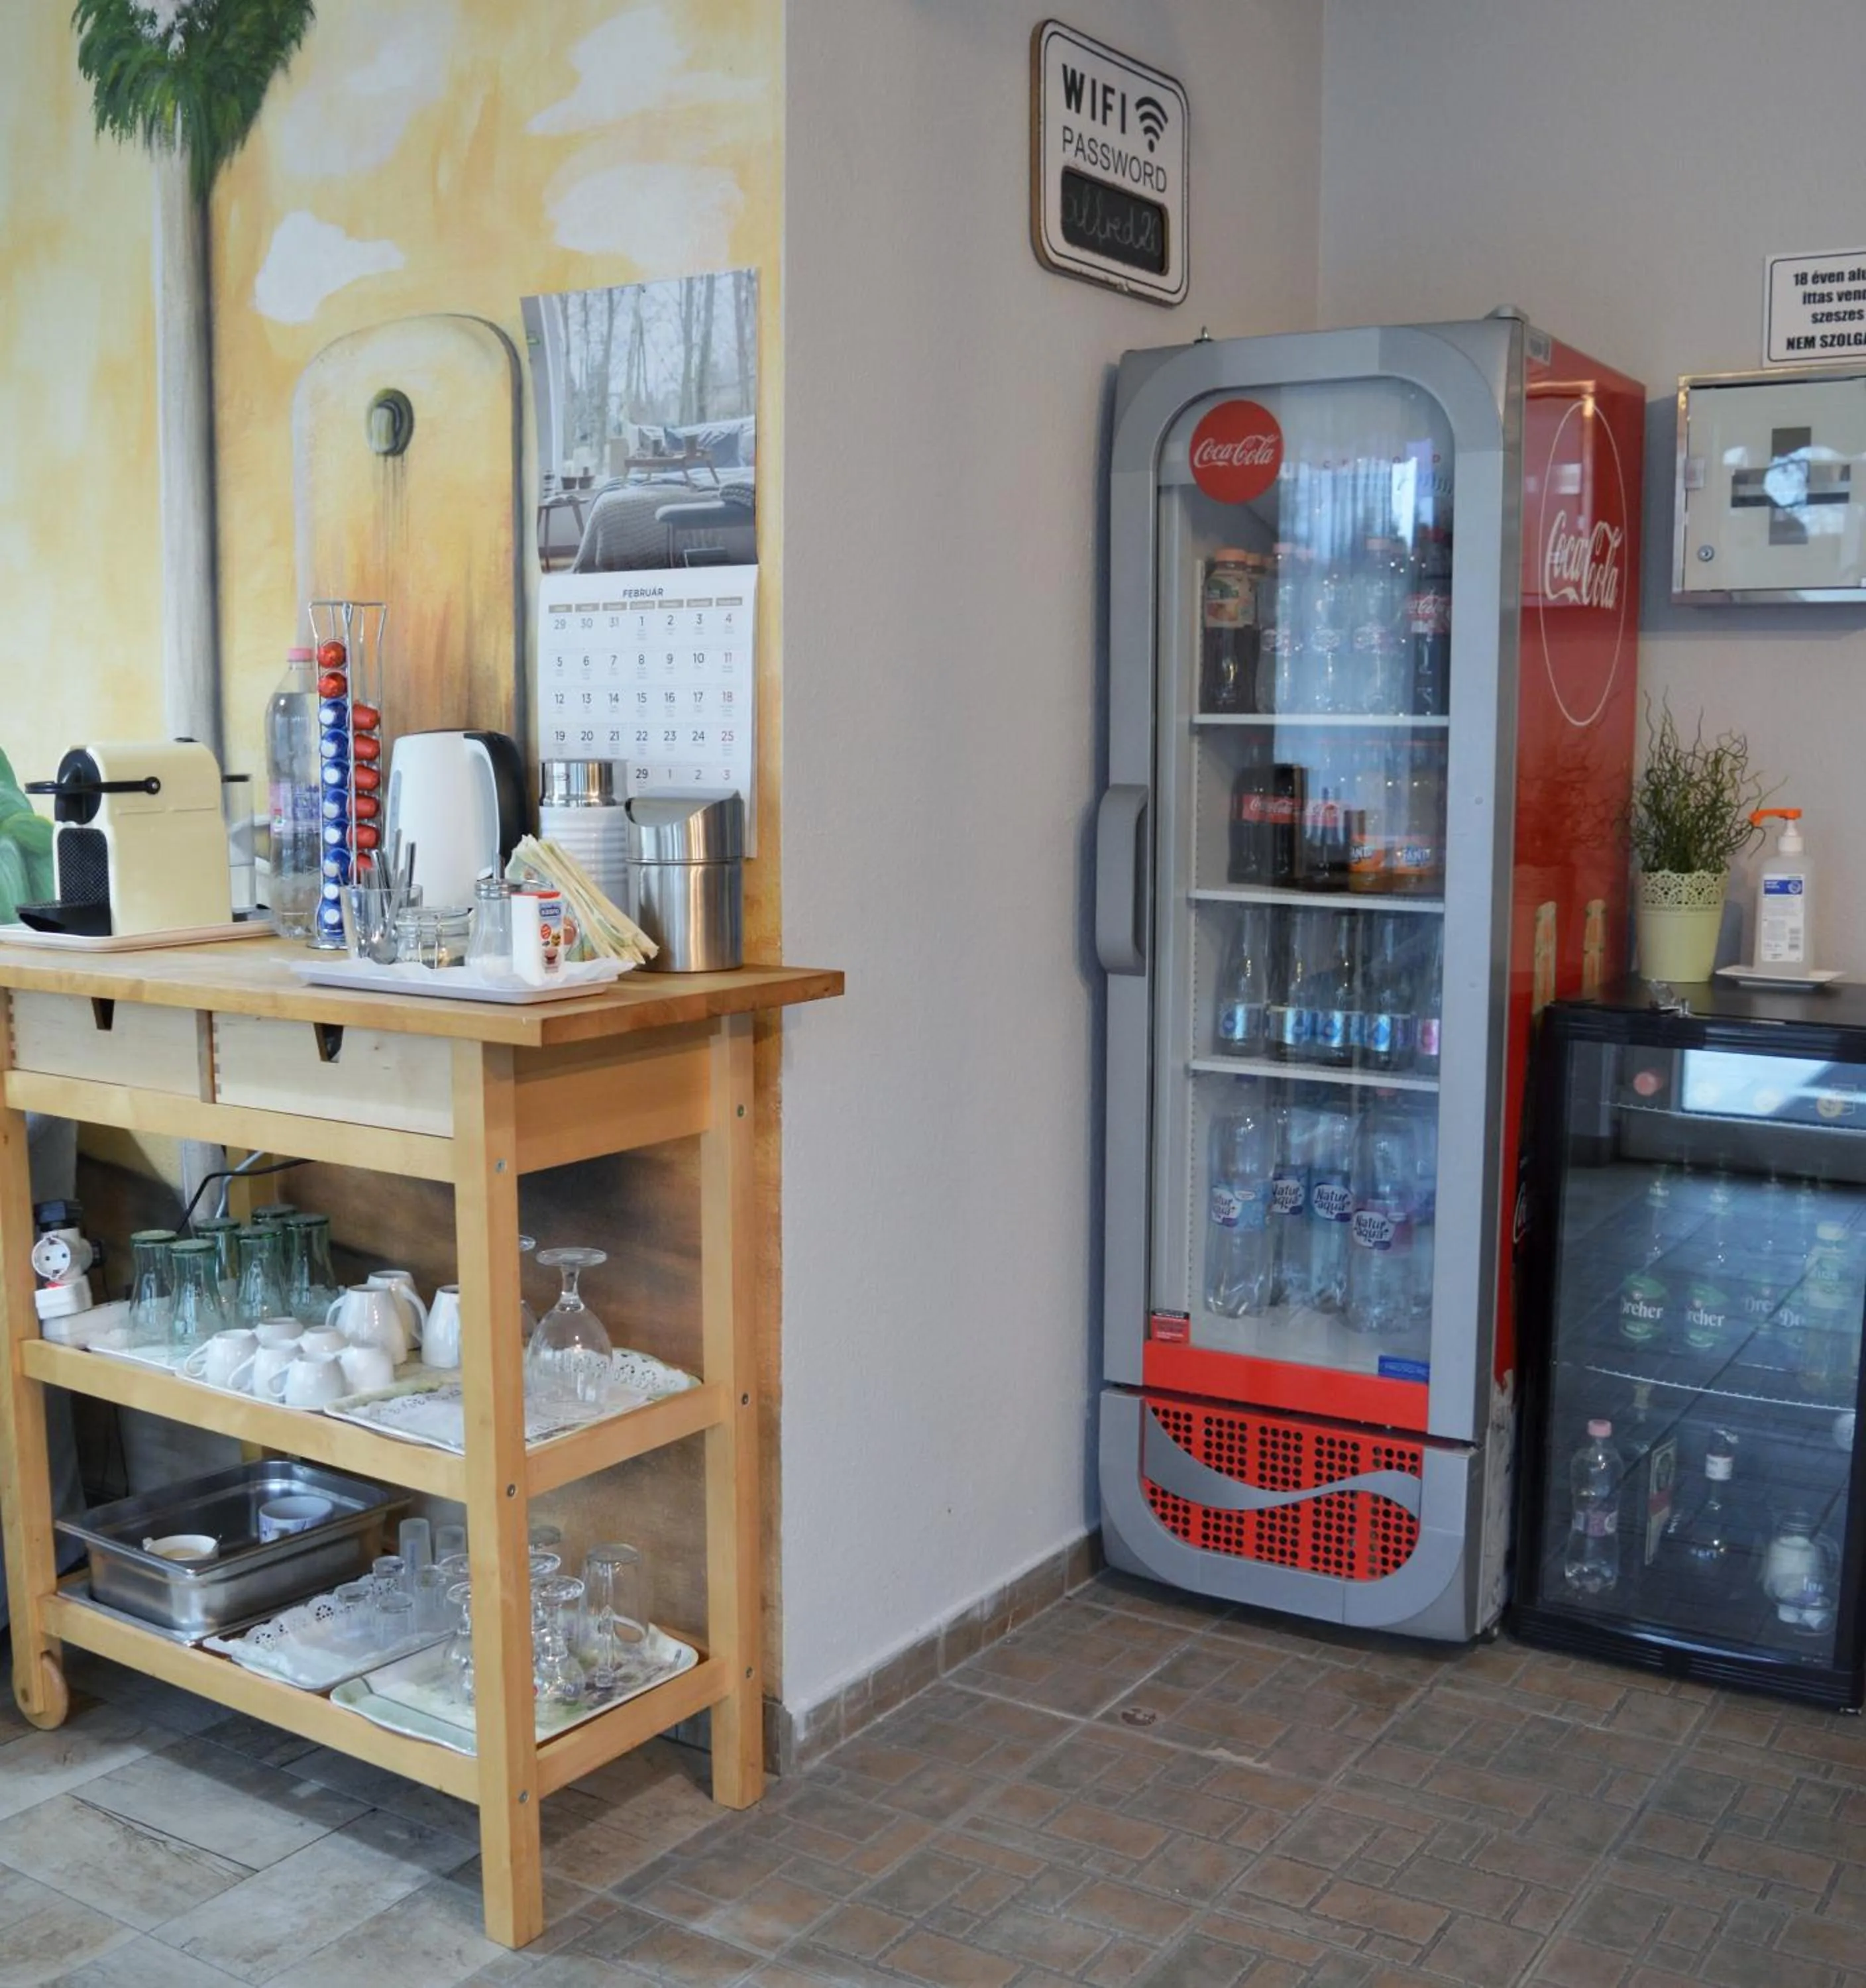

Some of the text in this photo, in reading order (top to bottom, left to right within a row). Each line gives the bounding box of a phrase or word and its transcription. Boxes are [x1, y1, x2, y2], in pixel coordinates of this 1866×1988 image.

[1062, 63, 1126, 134] WIFI
[1062, 126, 1167, 193] PASSWORD
[1793, 272, 1808, 286] 18
[1811, 270, 1845, 285] éven
[1811, 309, 1865, 324] szeszes
[1786, 336, 1816, 351] NEM
[553, 613, 732, 630] 29 30 31 1 2 3 4
[557, 651, 732, 667] 5 6 7 8 9 10 11
[555, 690, 733, 704] 12 13 14 15 16 17 18
[555, 730, 734, 742] 19 20 21 22 23 24 25
[635, 768, 731, 781] 29 1 2 3
